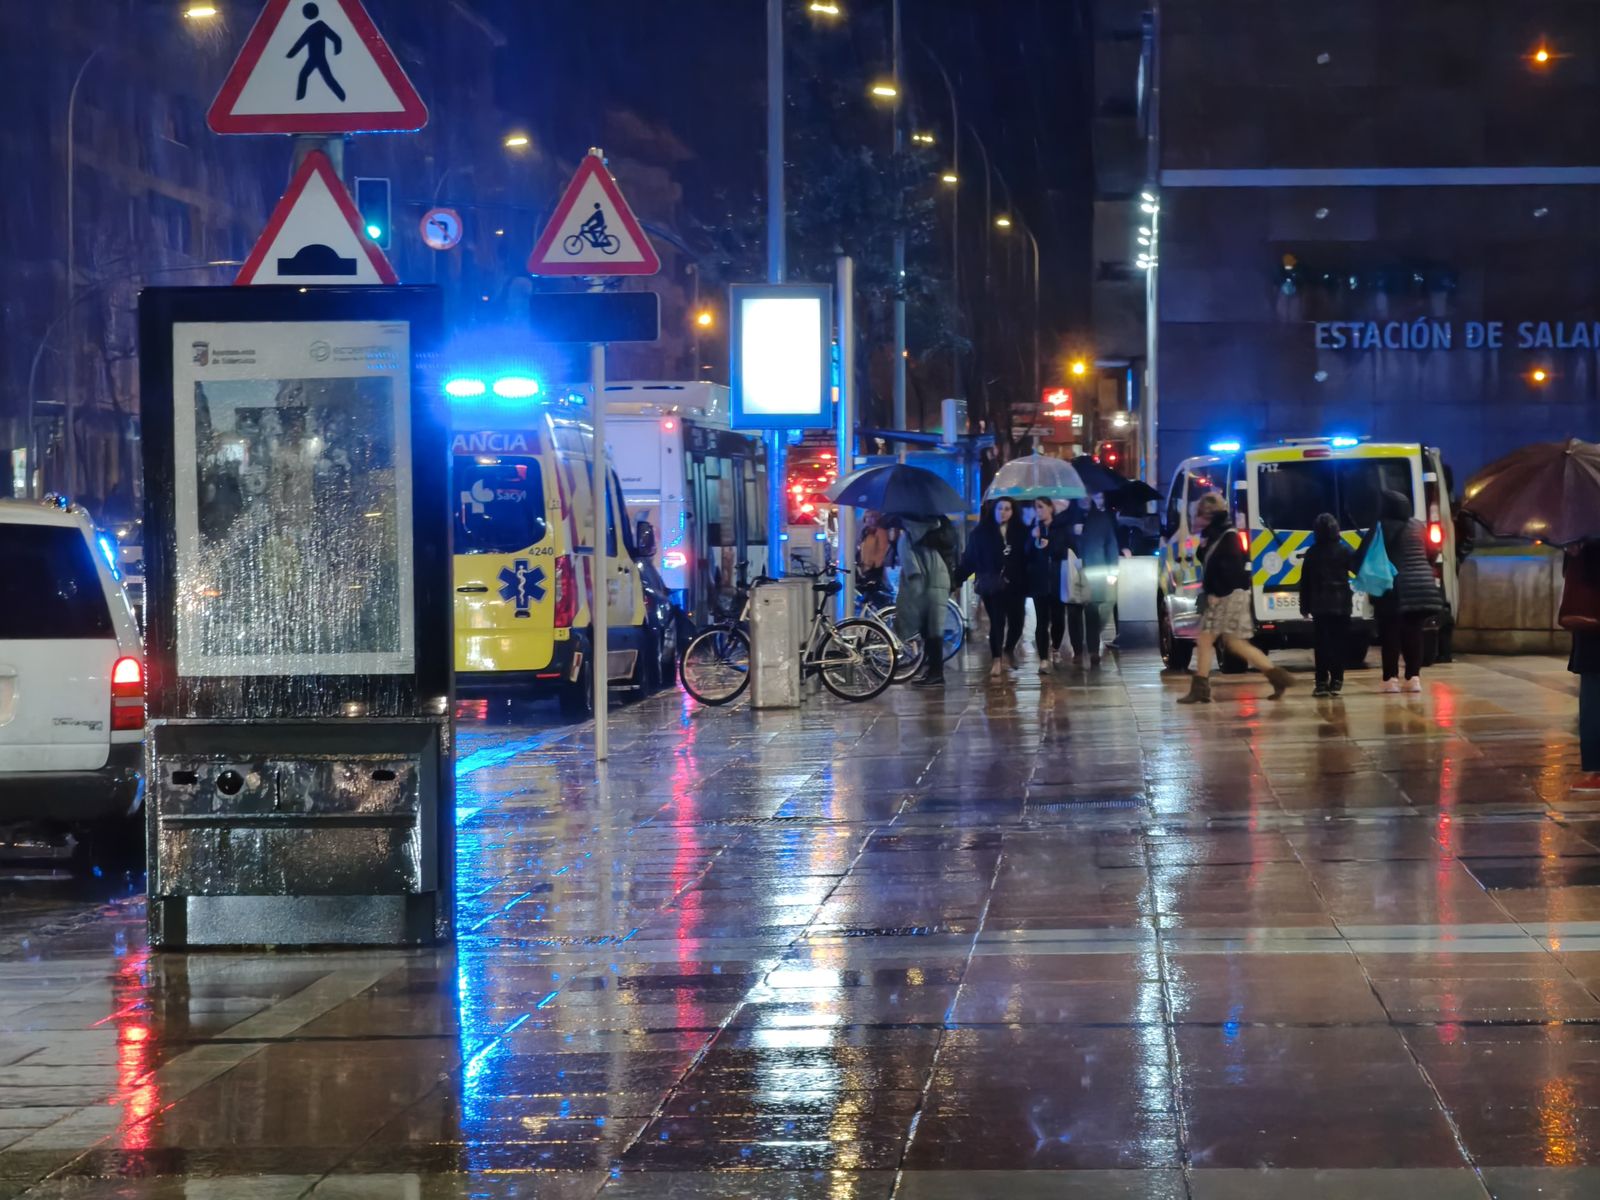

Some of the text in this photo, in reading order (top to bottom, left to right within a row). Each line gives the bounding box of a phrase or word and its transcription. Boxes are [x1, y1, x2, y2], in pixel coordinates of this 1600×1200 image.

[1315, 316, 1451, 349] ESTACIÓN
[1465, 321, 1503, 349] DE
[528, 546, 555, 557] 4240
